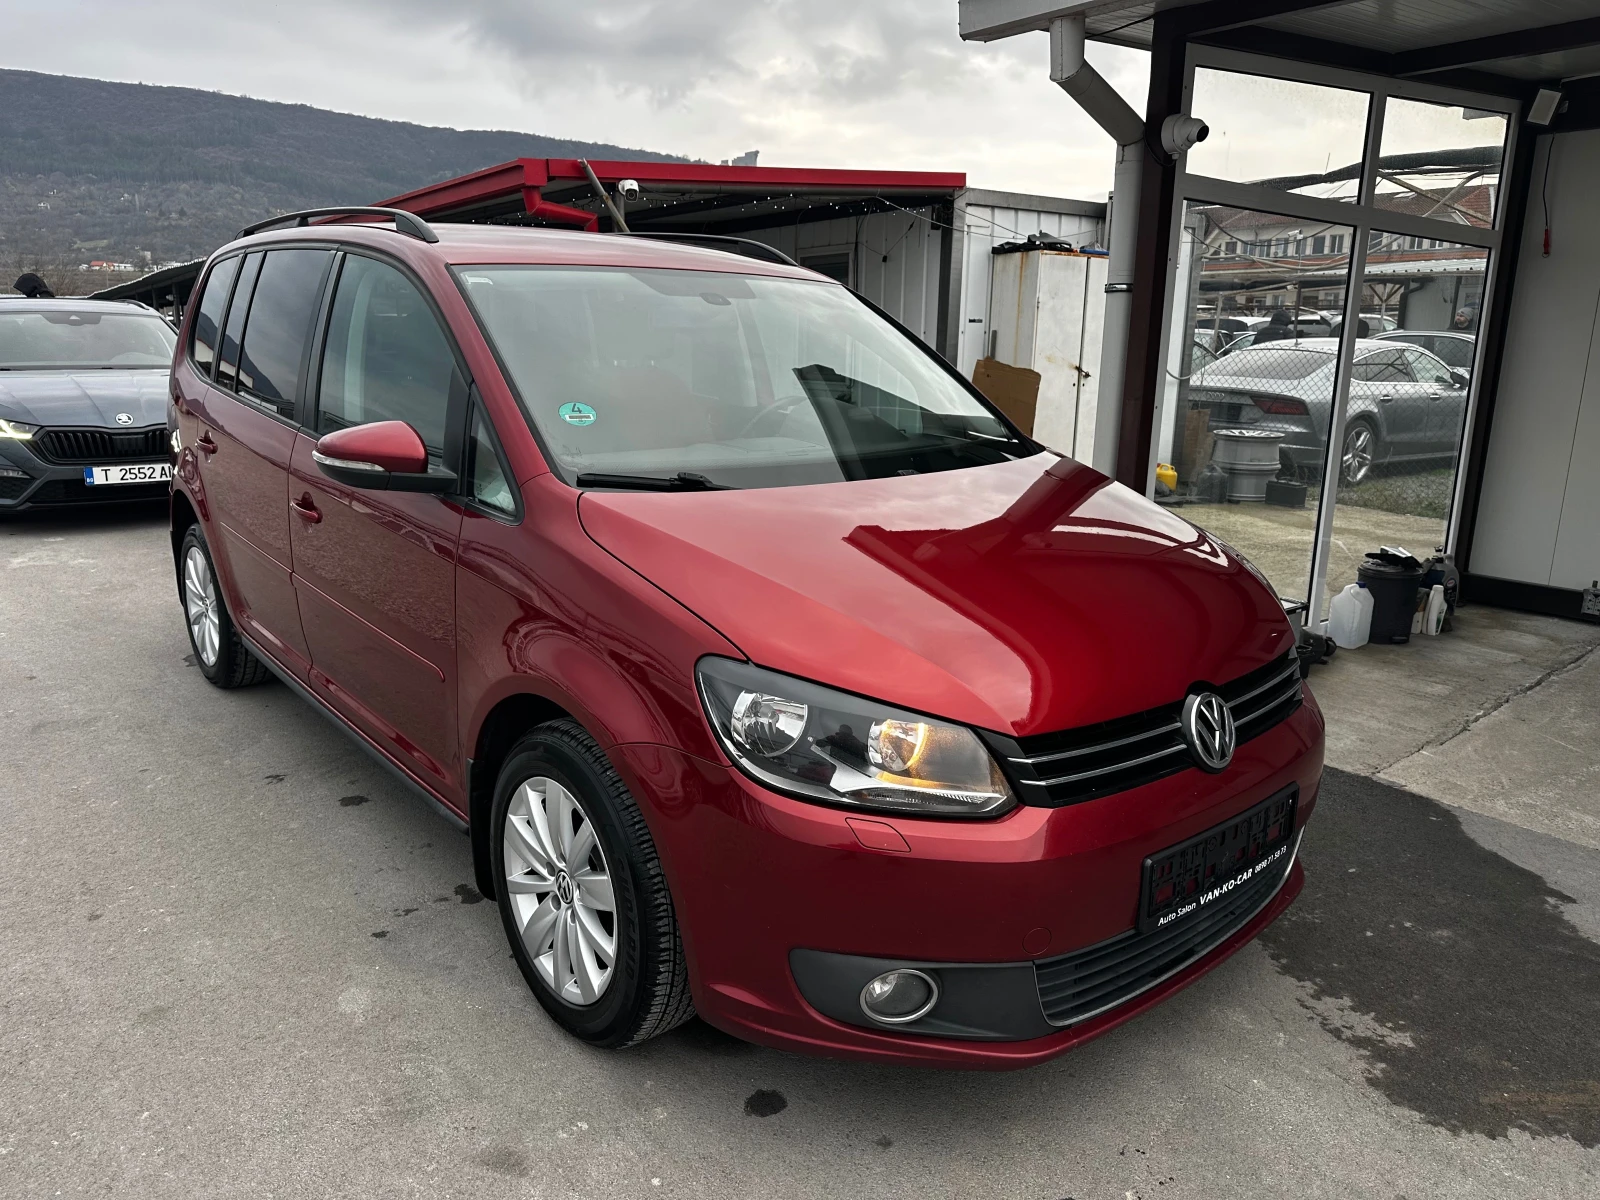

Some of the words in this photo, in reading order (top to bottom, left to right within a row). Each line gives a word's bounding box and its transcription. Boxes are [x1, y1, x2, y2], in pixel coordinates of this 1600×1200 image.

[571, 403, 582, 414] 4
[100, 468, 111, 482] T
[119, 466, 157, 481] 2552
[1157, 912, 1176, 927] Auto
[1176, 902, 1197, 917] Salon
[1199, 868, 1253, 905] VAN-KO-CAR
